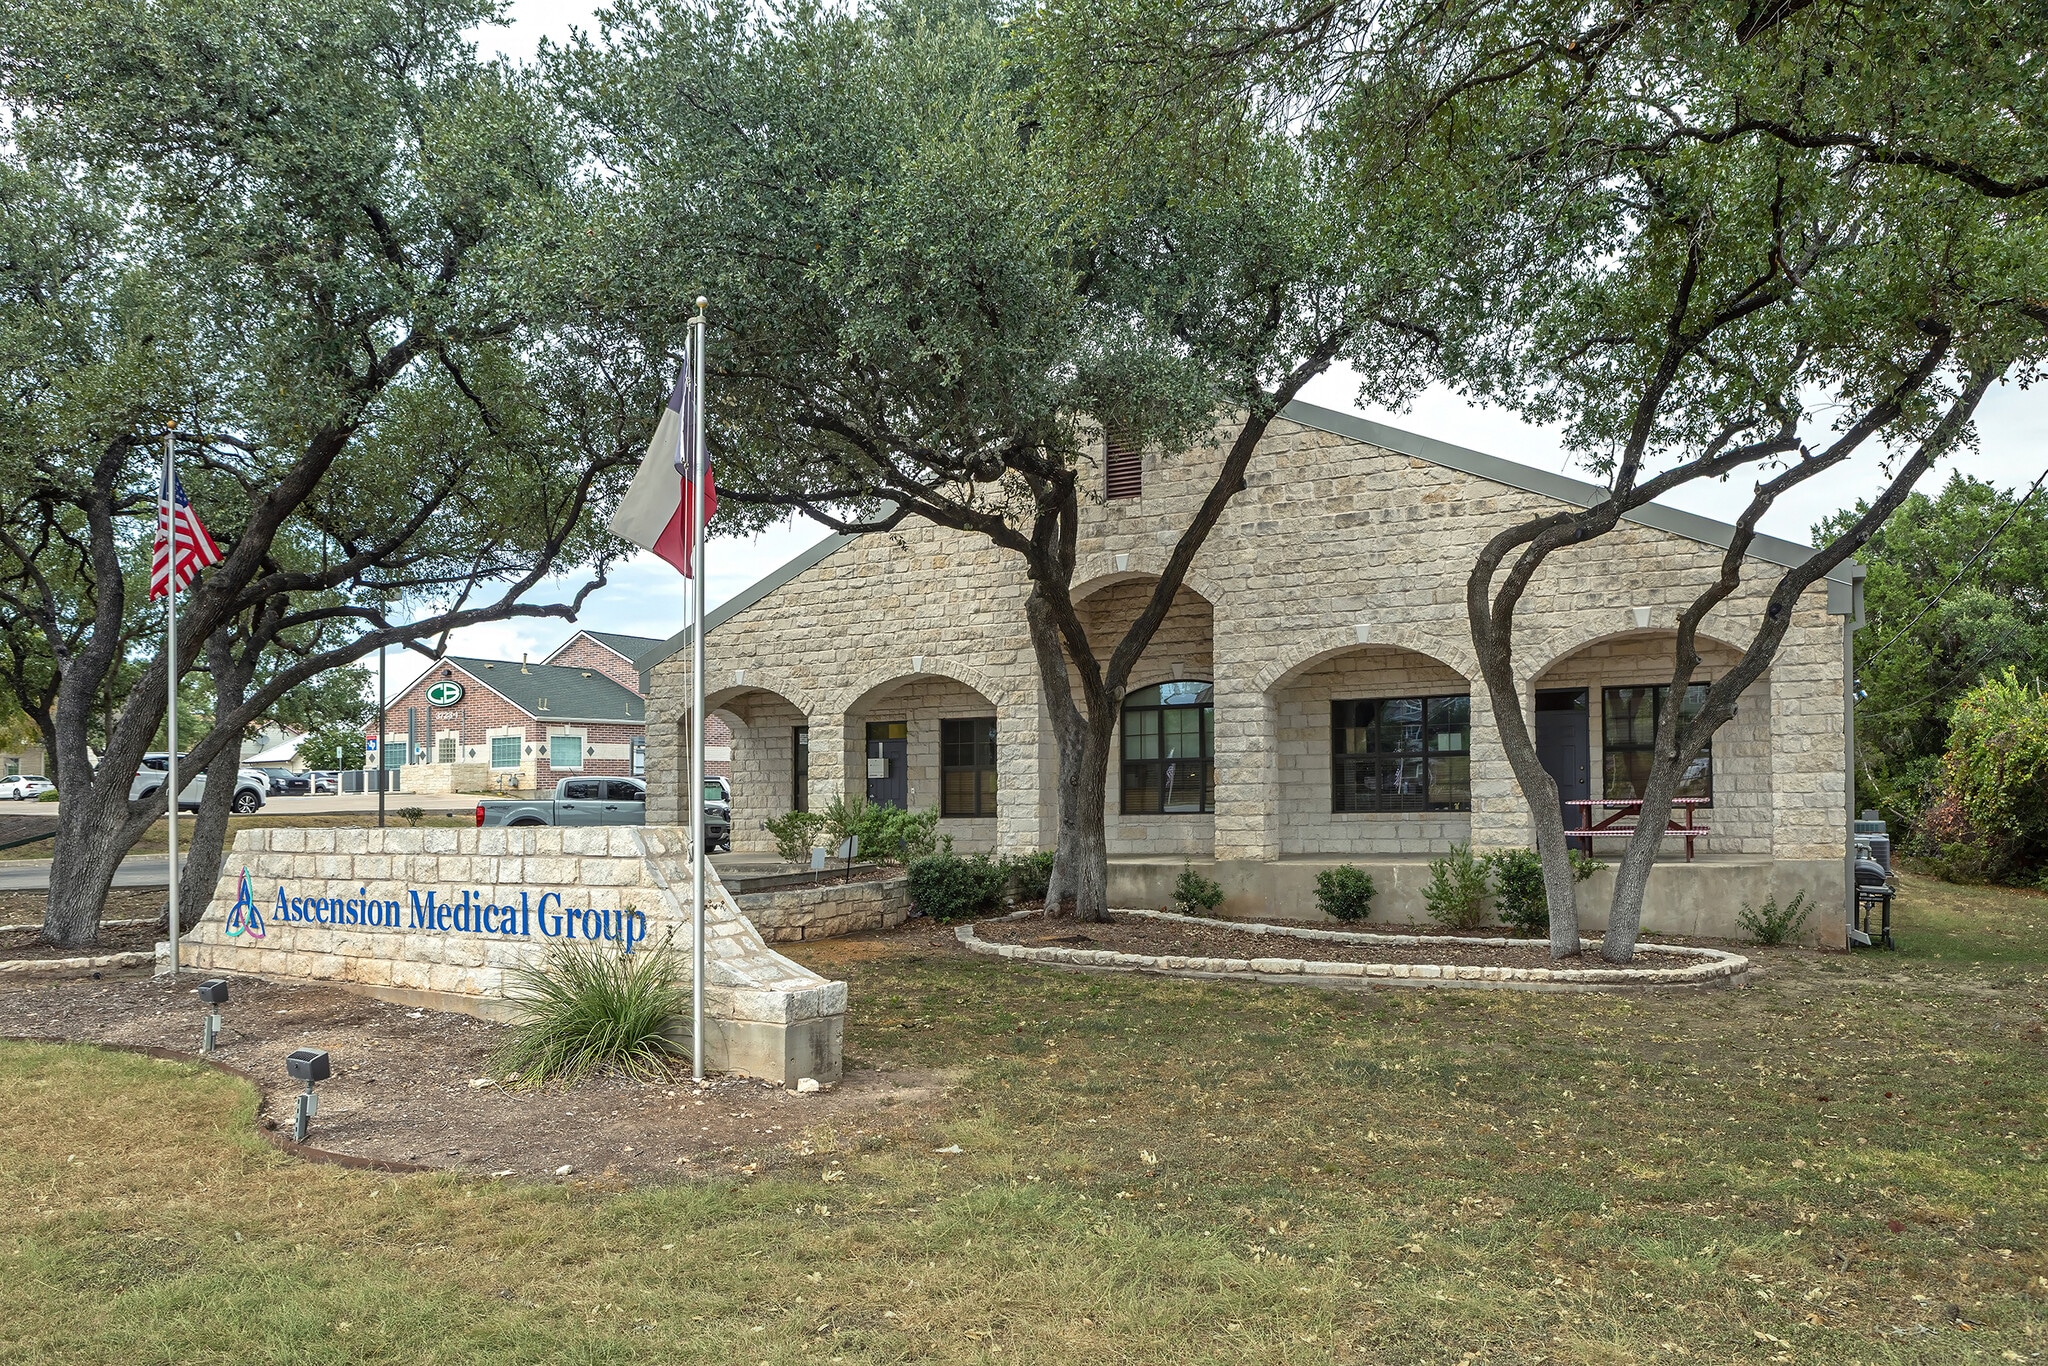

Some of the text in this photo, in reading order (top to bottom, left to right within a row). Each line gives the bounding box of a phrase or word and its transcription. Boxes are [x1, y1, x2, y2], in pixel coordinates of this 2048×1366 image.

[427, 682, 460, 704] CB
[272, 885, 647, 955] Ascension Medical Group
